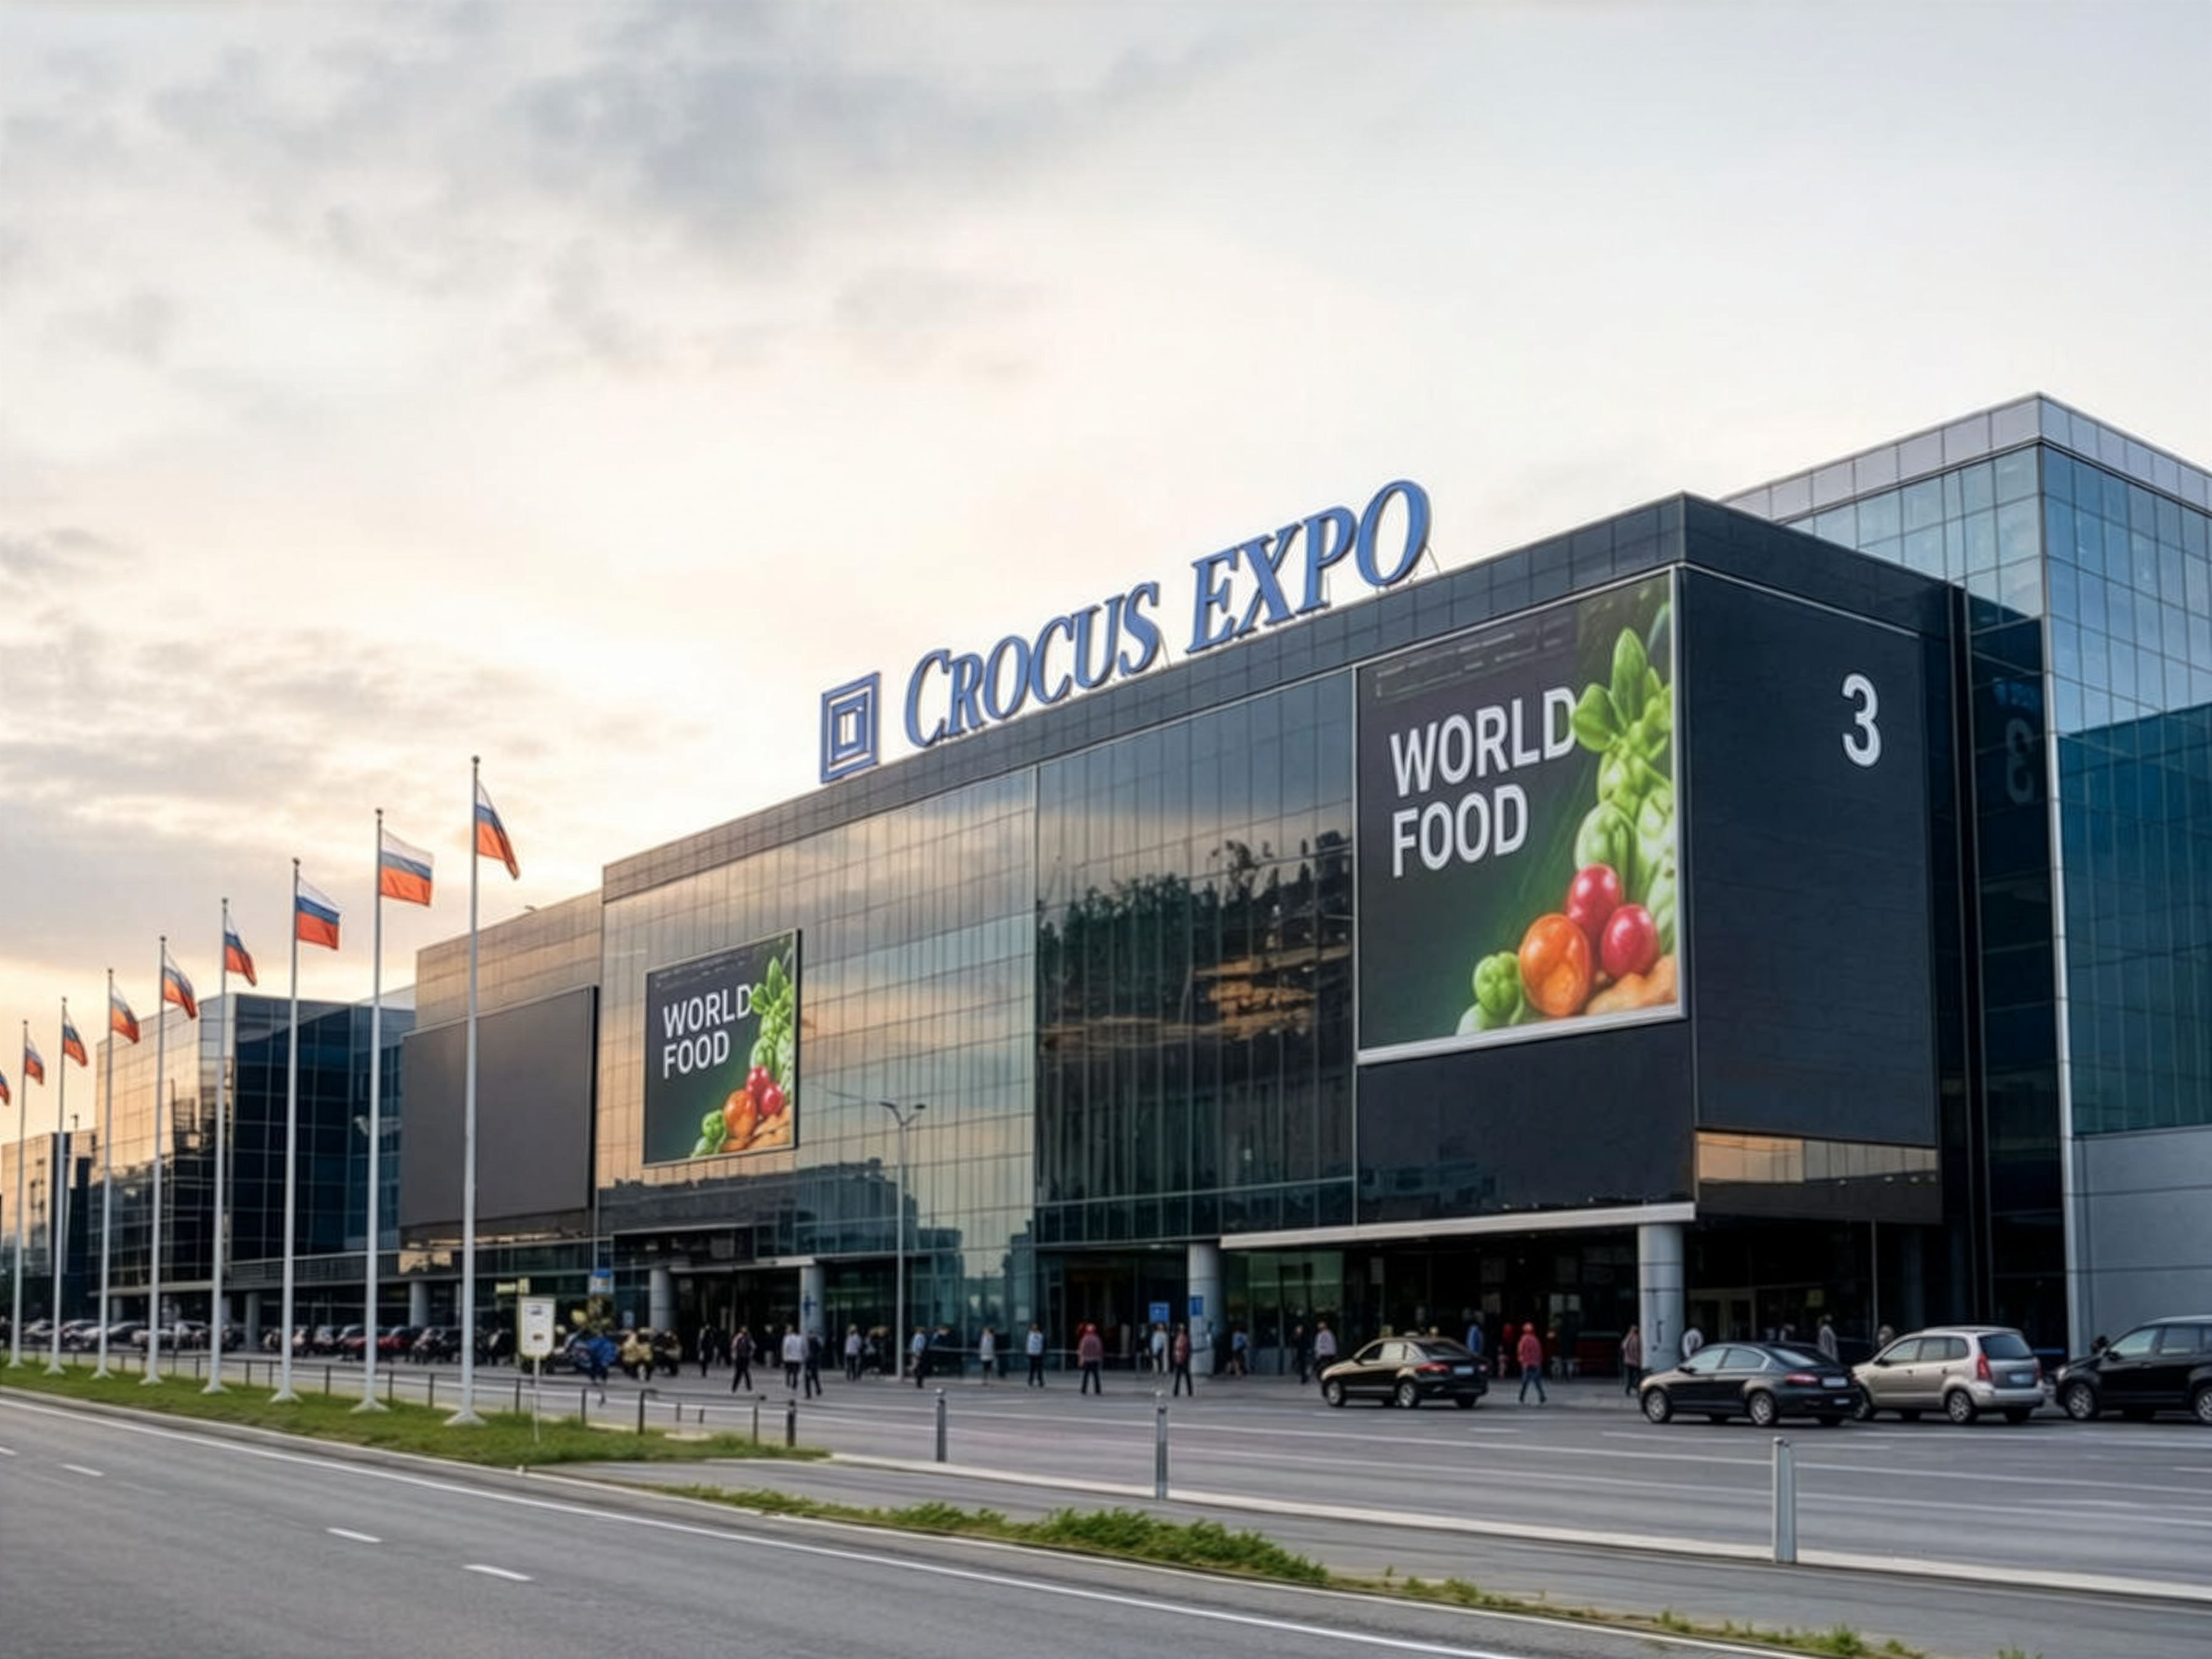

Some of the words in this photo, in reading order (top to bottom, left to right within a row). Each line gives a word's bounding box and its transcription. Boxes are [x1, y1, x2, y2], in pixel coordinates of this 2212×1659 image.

[905, 582, 1159, 747] CROCUS
[1186, 480, 1430, 653] EXPO
[1390, 688, 1577, 797] WORLD
[1842, 673, 1881, 767] 3
[1393, 784, 1527, 877] FOOD
[663, 984, 751, 1037] WORLD
[664, 1030, 729, 1078] FOOD
